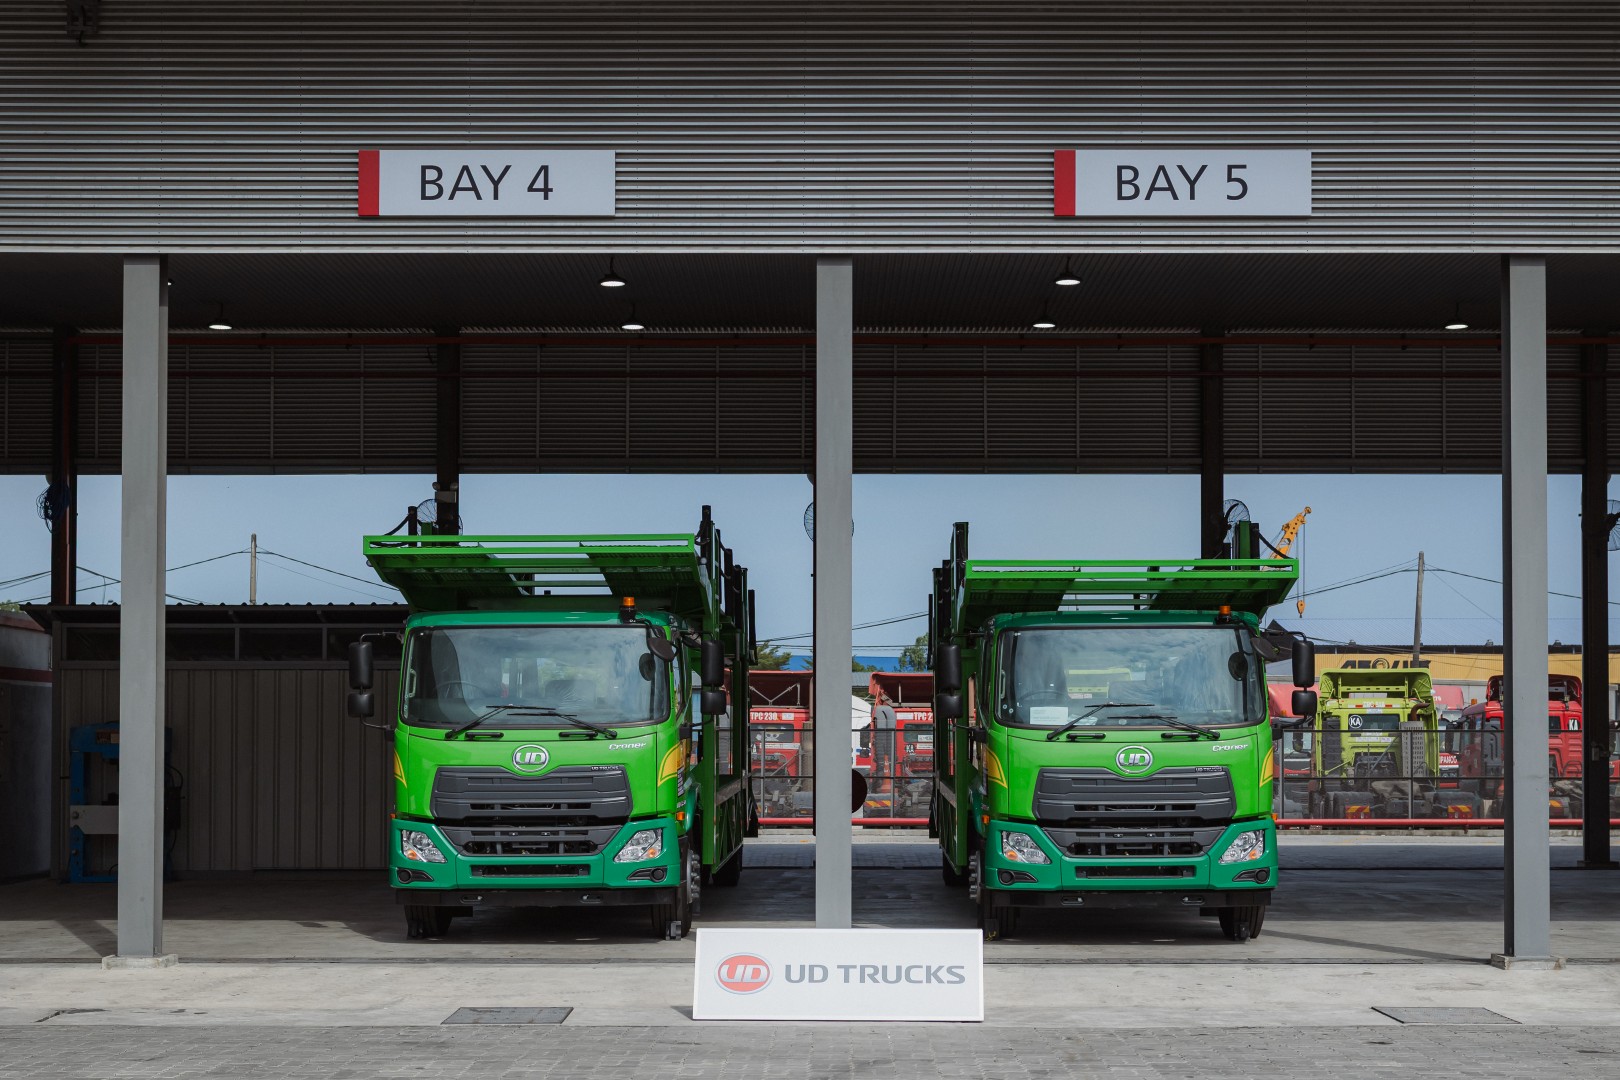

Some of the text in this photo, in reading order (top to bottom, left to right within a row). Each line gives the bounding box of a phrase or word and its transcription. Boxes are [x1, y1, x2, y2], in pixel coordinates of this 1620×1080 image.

[420, 164, 553, 200] BAY 4
[1116, 164, 1248, 200] BAY 5
[751, 712, 763, 720] TPC
[914, 712, 927, 720] TPC
[1351, 717, 1361, 726] KA
[1569, 719, 1579, 731] KA
[609, 742, 646, 750] Croner
[1212, 744, 1248, 752] Croner
[515, 751, 546, 764] UD
[1119, 753, 1150, 766] UD
[720, 964, 966, 984] UD UD TRUCKS
